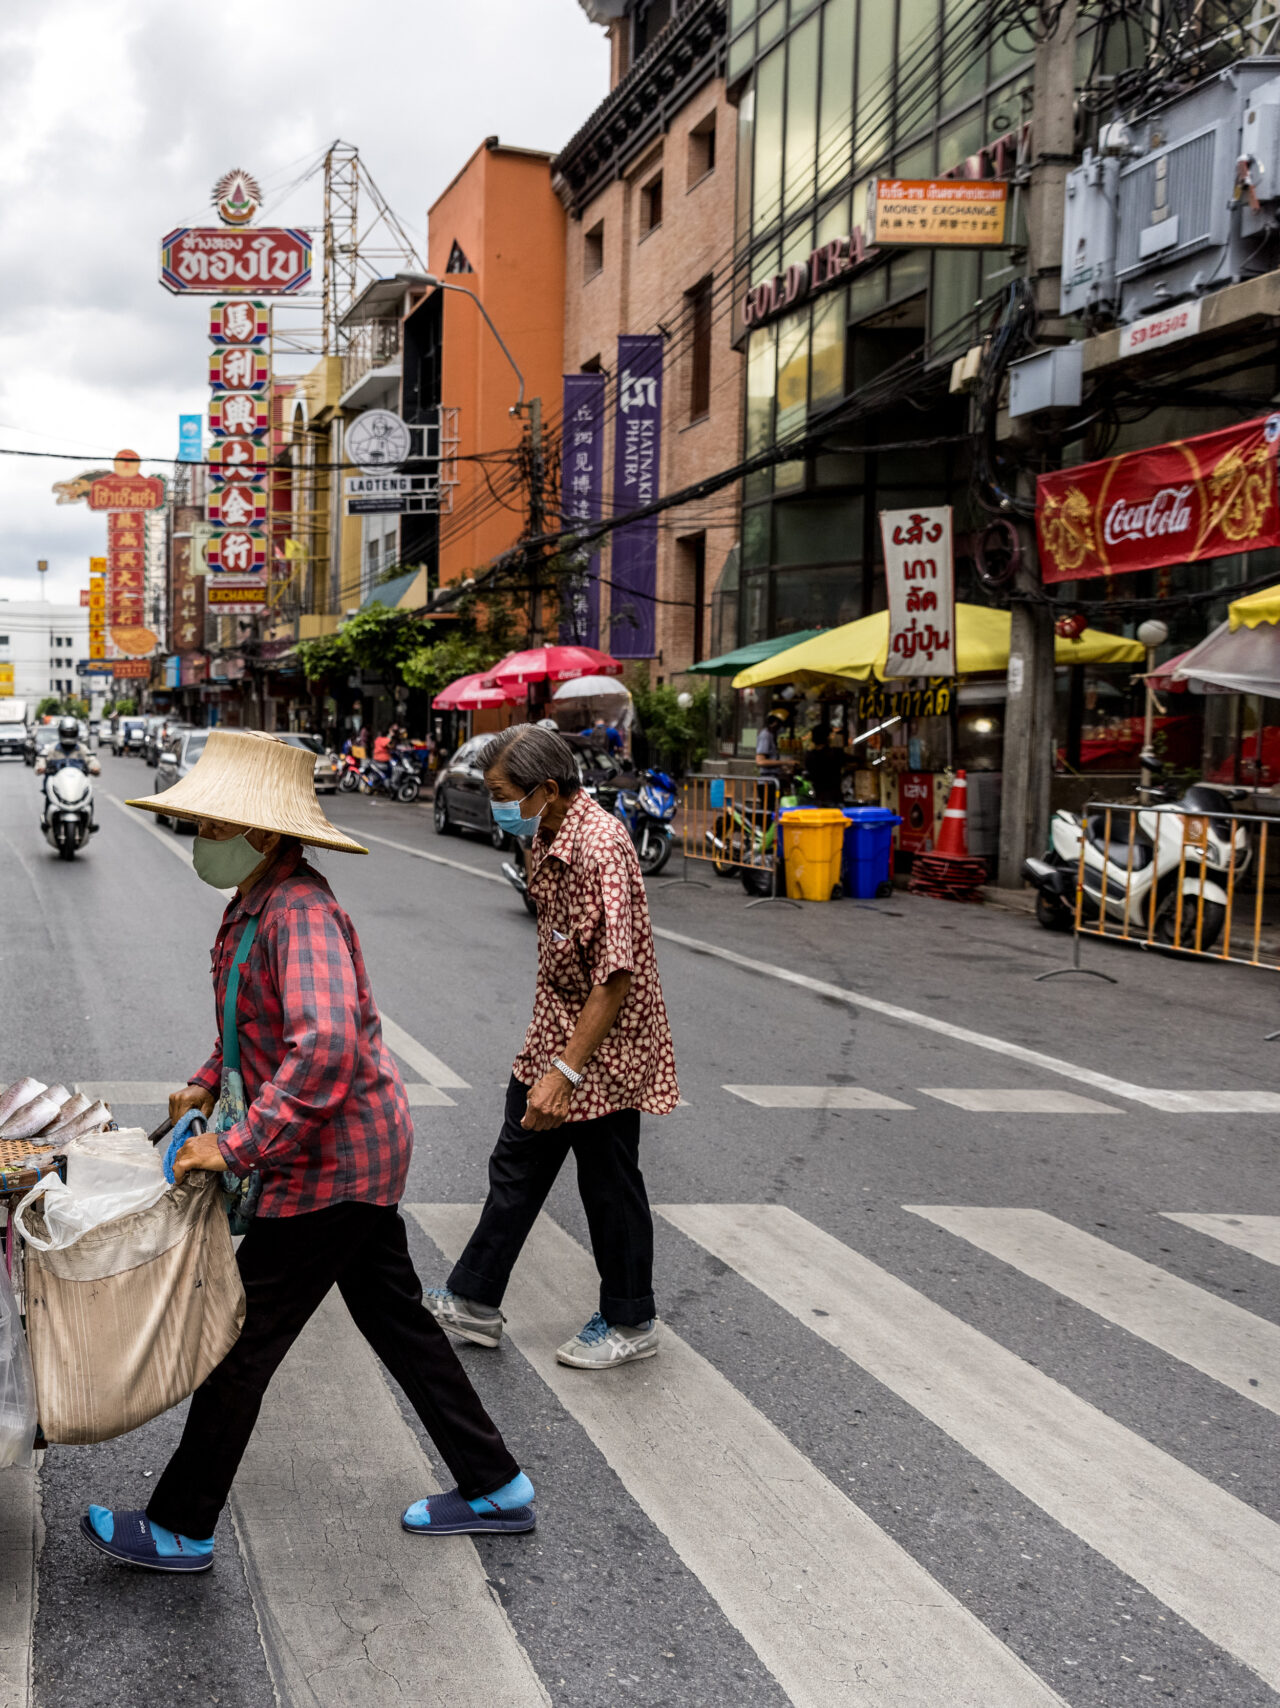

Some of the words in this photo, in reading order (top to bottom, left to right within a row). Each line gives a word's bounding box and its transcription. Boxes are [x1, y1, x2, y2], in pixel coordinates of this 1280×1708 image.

[883, 204, 926, 215] MONEY
[932, 205, 999, 217] EXCHANGE
[741, 261, 807, 325] GOLD
[624, 419, 641, 486] PHATRA
[350, 479, 407, 492] LAOTENG
[892, 514, 943, 545] เล้ง
[904, 558, 937, 580] เกา
[209, 589, 266, 602] EXCHANGE
